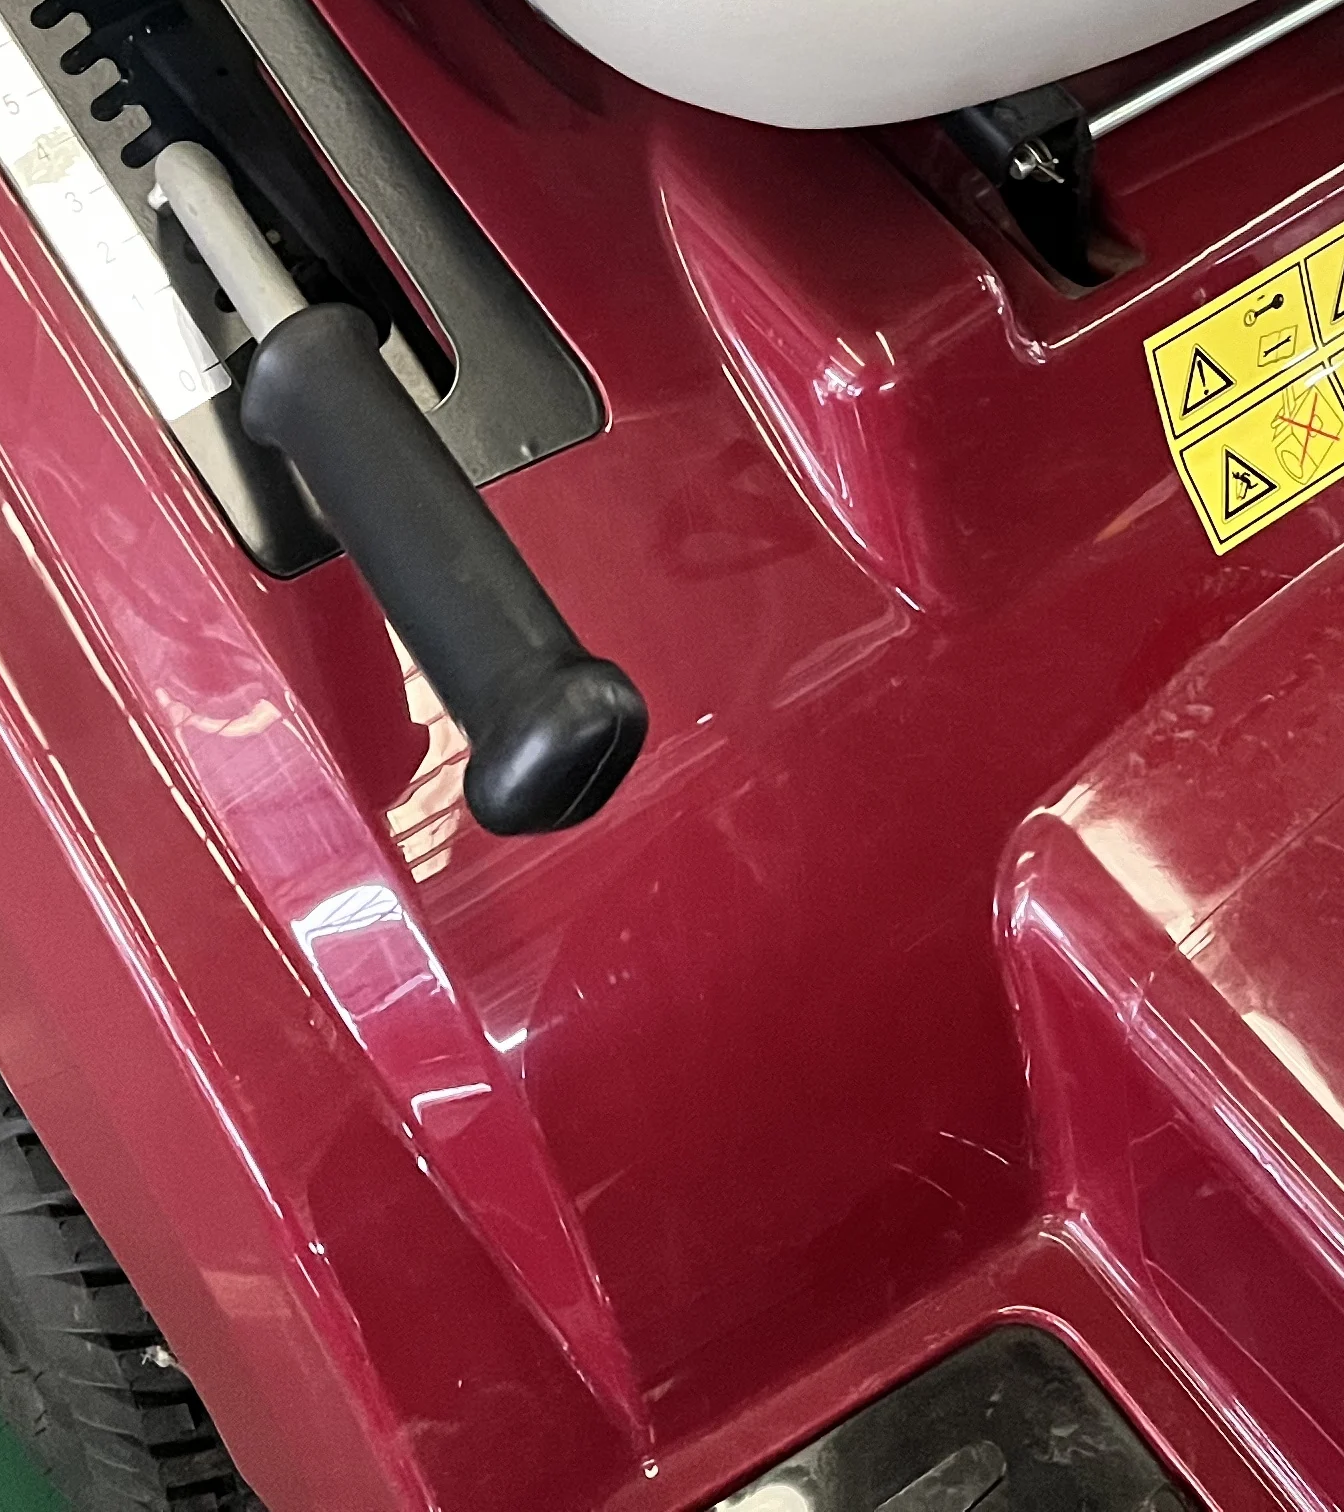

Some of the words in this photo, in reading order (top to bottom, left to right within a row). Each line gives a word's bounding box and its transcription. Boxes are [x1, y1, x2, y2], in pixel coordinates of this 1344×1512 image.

[2, 93, 20, 115] 5
[36, 138, 52, 161] 4
[64, 191, 83, 213] 3
[96, 241, 117, 265] 2
[131, 293, 145, 311] 1
[178, 369, 197, 392] 0
